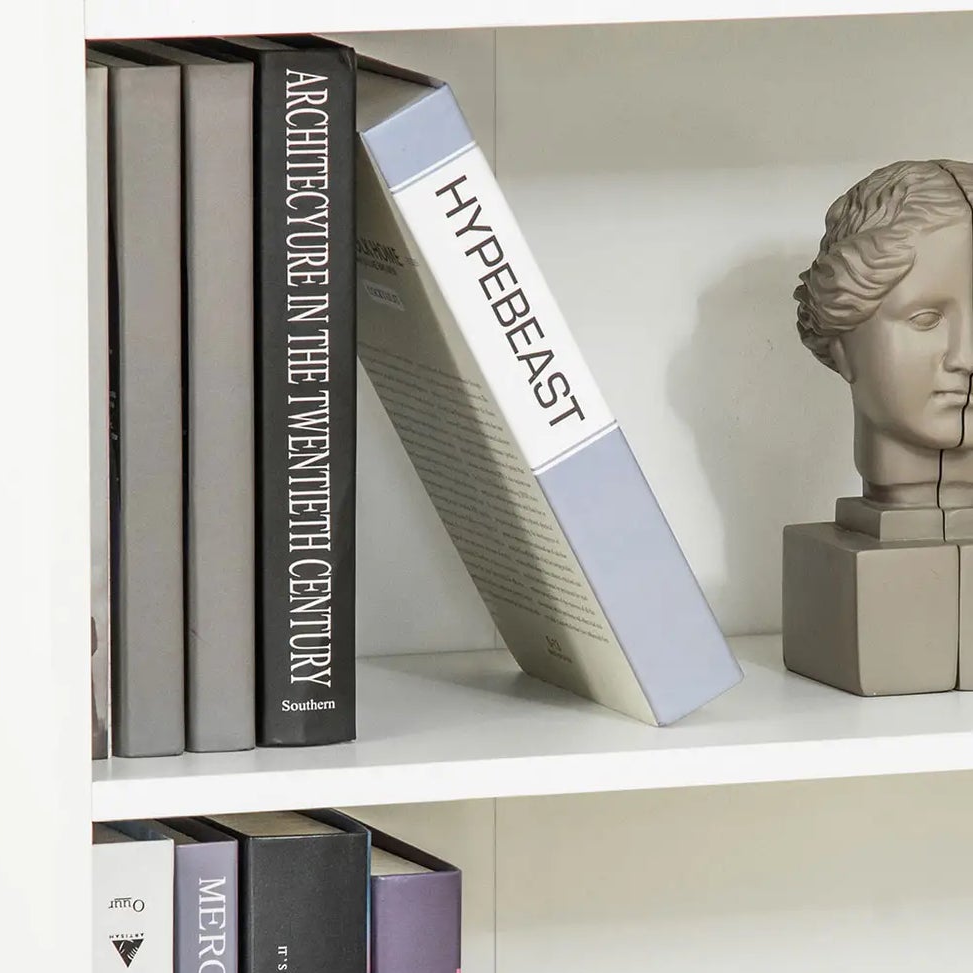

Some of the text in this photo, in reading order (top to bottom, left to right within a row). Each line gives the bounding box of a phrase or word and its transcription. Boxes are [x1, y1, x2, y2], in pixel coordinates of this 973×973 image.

[285, 69, 332, 688] ARCHITECYURE IN THE TWENTIETH CENTURY
[435, 174, 586, 427] HYPEBEAST
[281, 699, 336, 713] Southern
